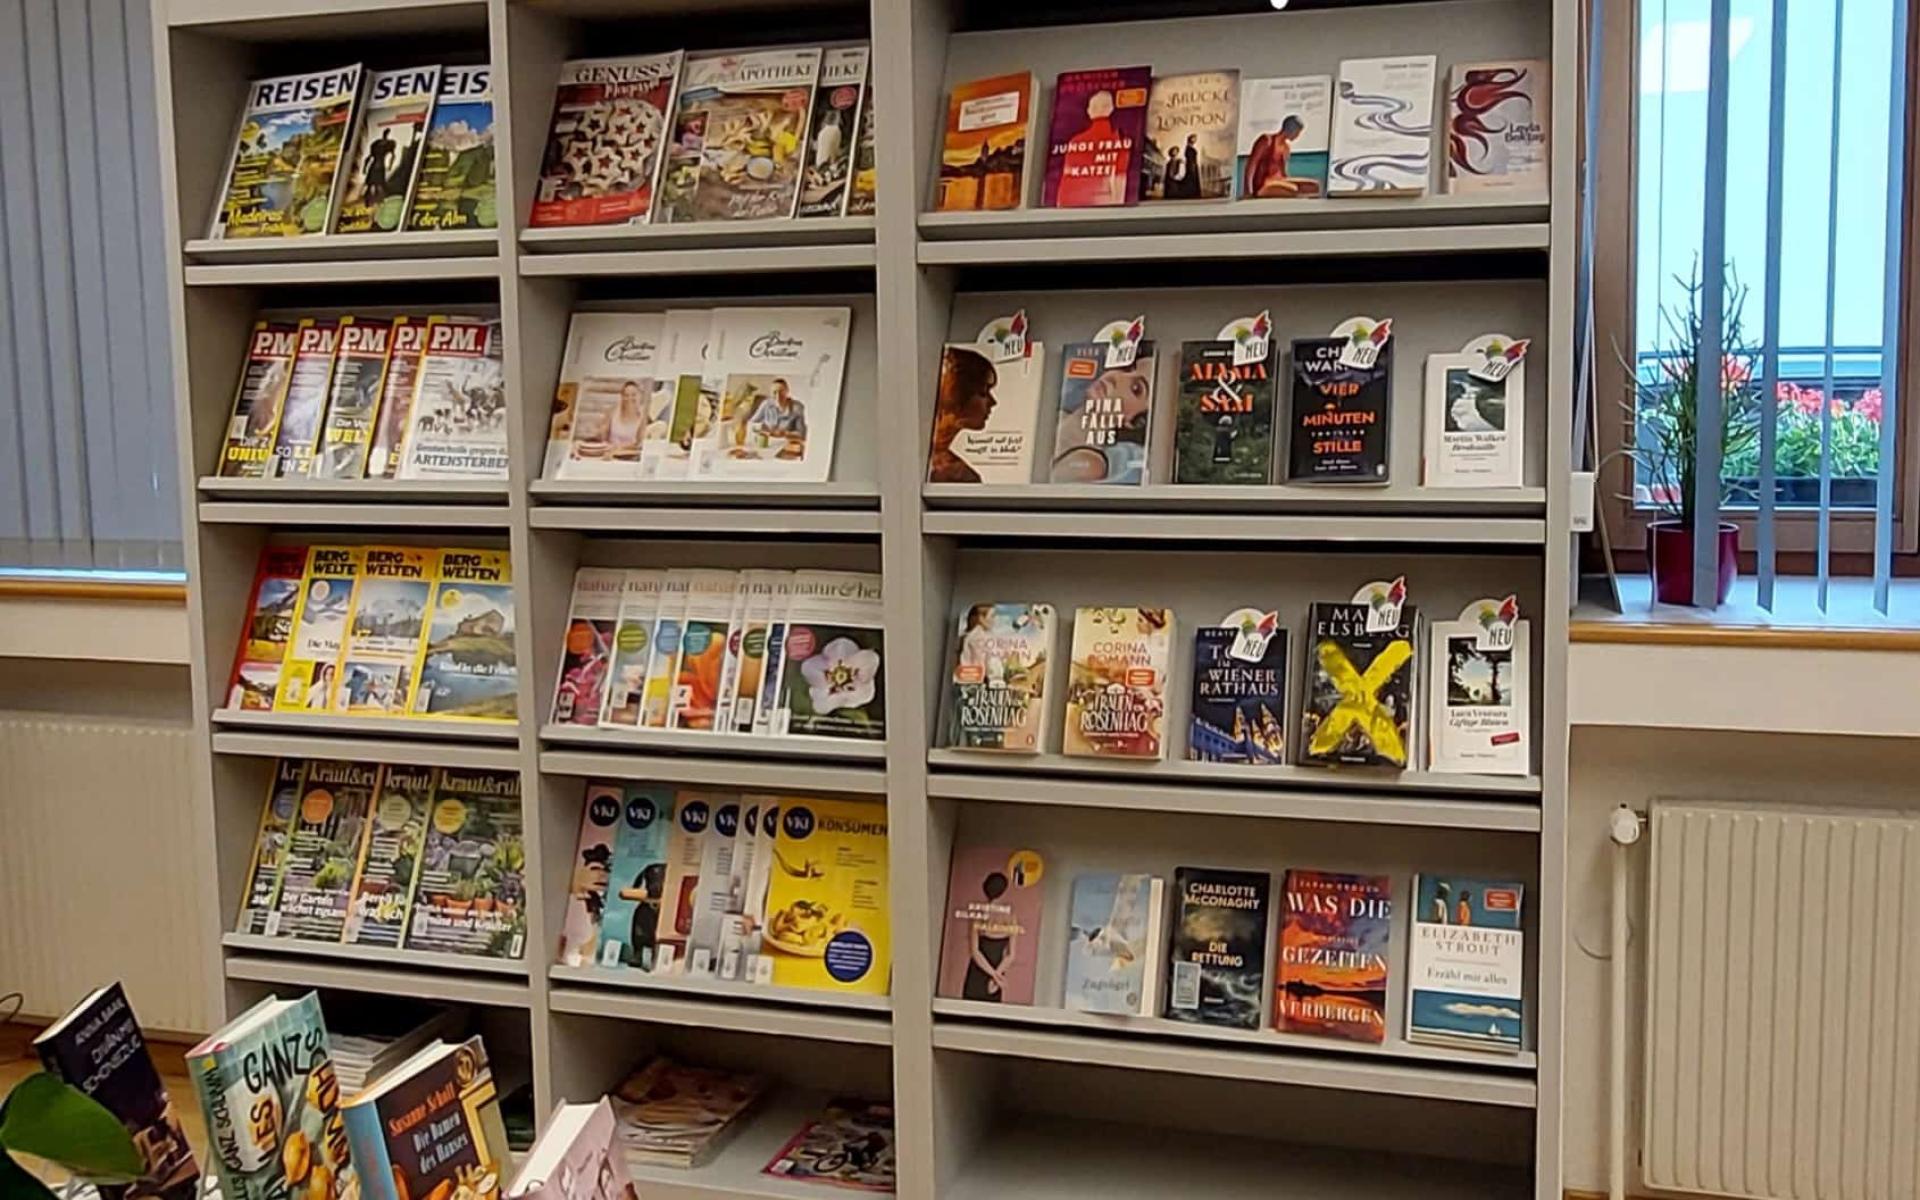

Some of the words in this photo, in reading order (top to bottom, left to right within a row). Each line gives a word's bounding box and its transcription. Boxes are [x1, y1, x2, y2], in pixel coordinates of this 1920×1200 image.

[576, 63, 661, 83] GENUSS
[256, 71, 356, 107] REISEN
[374, 71, 435, 100] SEN
[1157, 113, 1227, 132] LONDON
[1052, 142, 1094, 154] JUNGE
[1099, 139, 1132, 150] FRAU
[1095, 152, 1118, 163] MIT
[431, 326, 482, 351] P.M.
[1004, 338, 1023, 356] NEU
[1246, 341, 1267, 359] NEU
[1352, 347, 1376, 364] NEU
[1482, 360, 1511, 378] NEU
[1320, 384, 1360, 396] VIER
[1303, 411, 1375, 426] MINUTEN
[1086, 429, 1116, 446] AUS
[1313, 440, 1362, 454] STILLE
[315, 550, 349, 562] BERG
[366, 551, 403, 564] BERG
[443, 554, 481, 567] BERG
[366, 564, 423, 578] WELTEN
[442, 567, 501, 580] WELTEN
[1379, 607, 1397, 626] NEU
[1317, 621, 1410, 638] ELSBG
[1488, 629, 1513, 646] NEU
[1093, 641, 1148, 653] CORINA
[1243, 638, 1265, 657] NEU
[1087, 654, 1152, 666] BOMANN
[1208, 669, 1276, 683] WIENER
[1200, 682, 1279, 696] RATHAUS
[817, 818, 888, 837] KONSUMEN
[1190, 882, 1256, 897] CHARLOTTE
[1184, 893, 1260, 910] McCONAGHY
[1287, 892, 1339, 915] WAS
[1350, 897, 1391, 919] DIE
[1421, 926, 1516, 946] ELIZABETH
[1209, 941, 1228, 953] DIE
[1435, 941, 1501, 956] STROUT
[1192, 952, 1243, 968] RETTUNG
[1282, 945, 1387, 972] GEZEITEN
[1427, 967, 1462, 980] Erzähl
[1463, 971, 1481, 981] mir
[1483, 973, 1508, 985] alles
[1279, 999, 1384, 1025] VERBERGEN
[243, 1032, 311, 1094] GANZ
